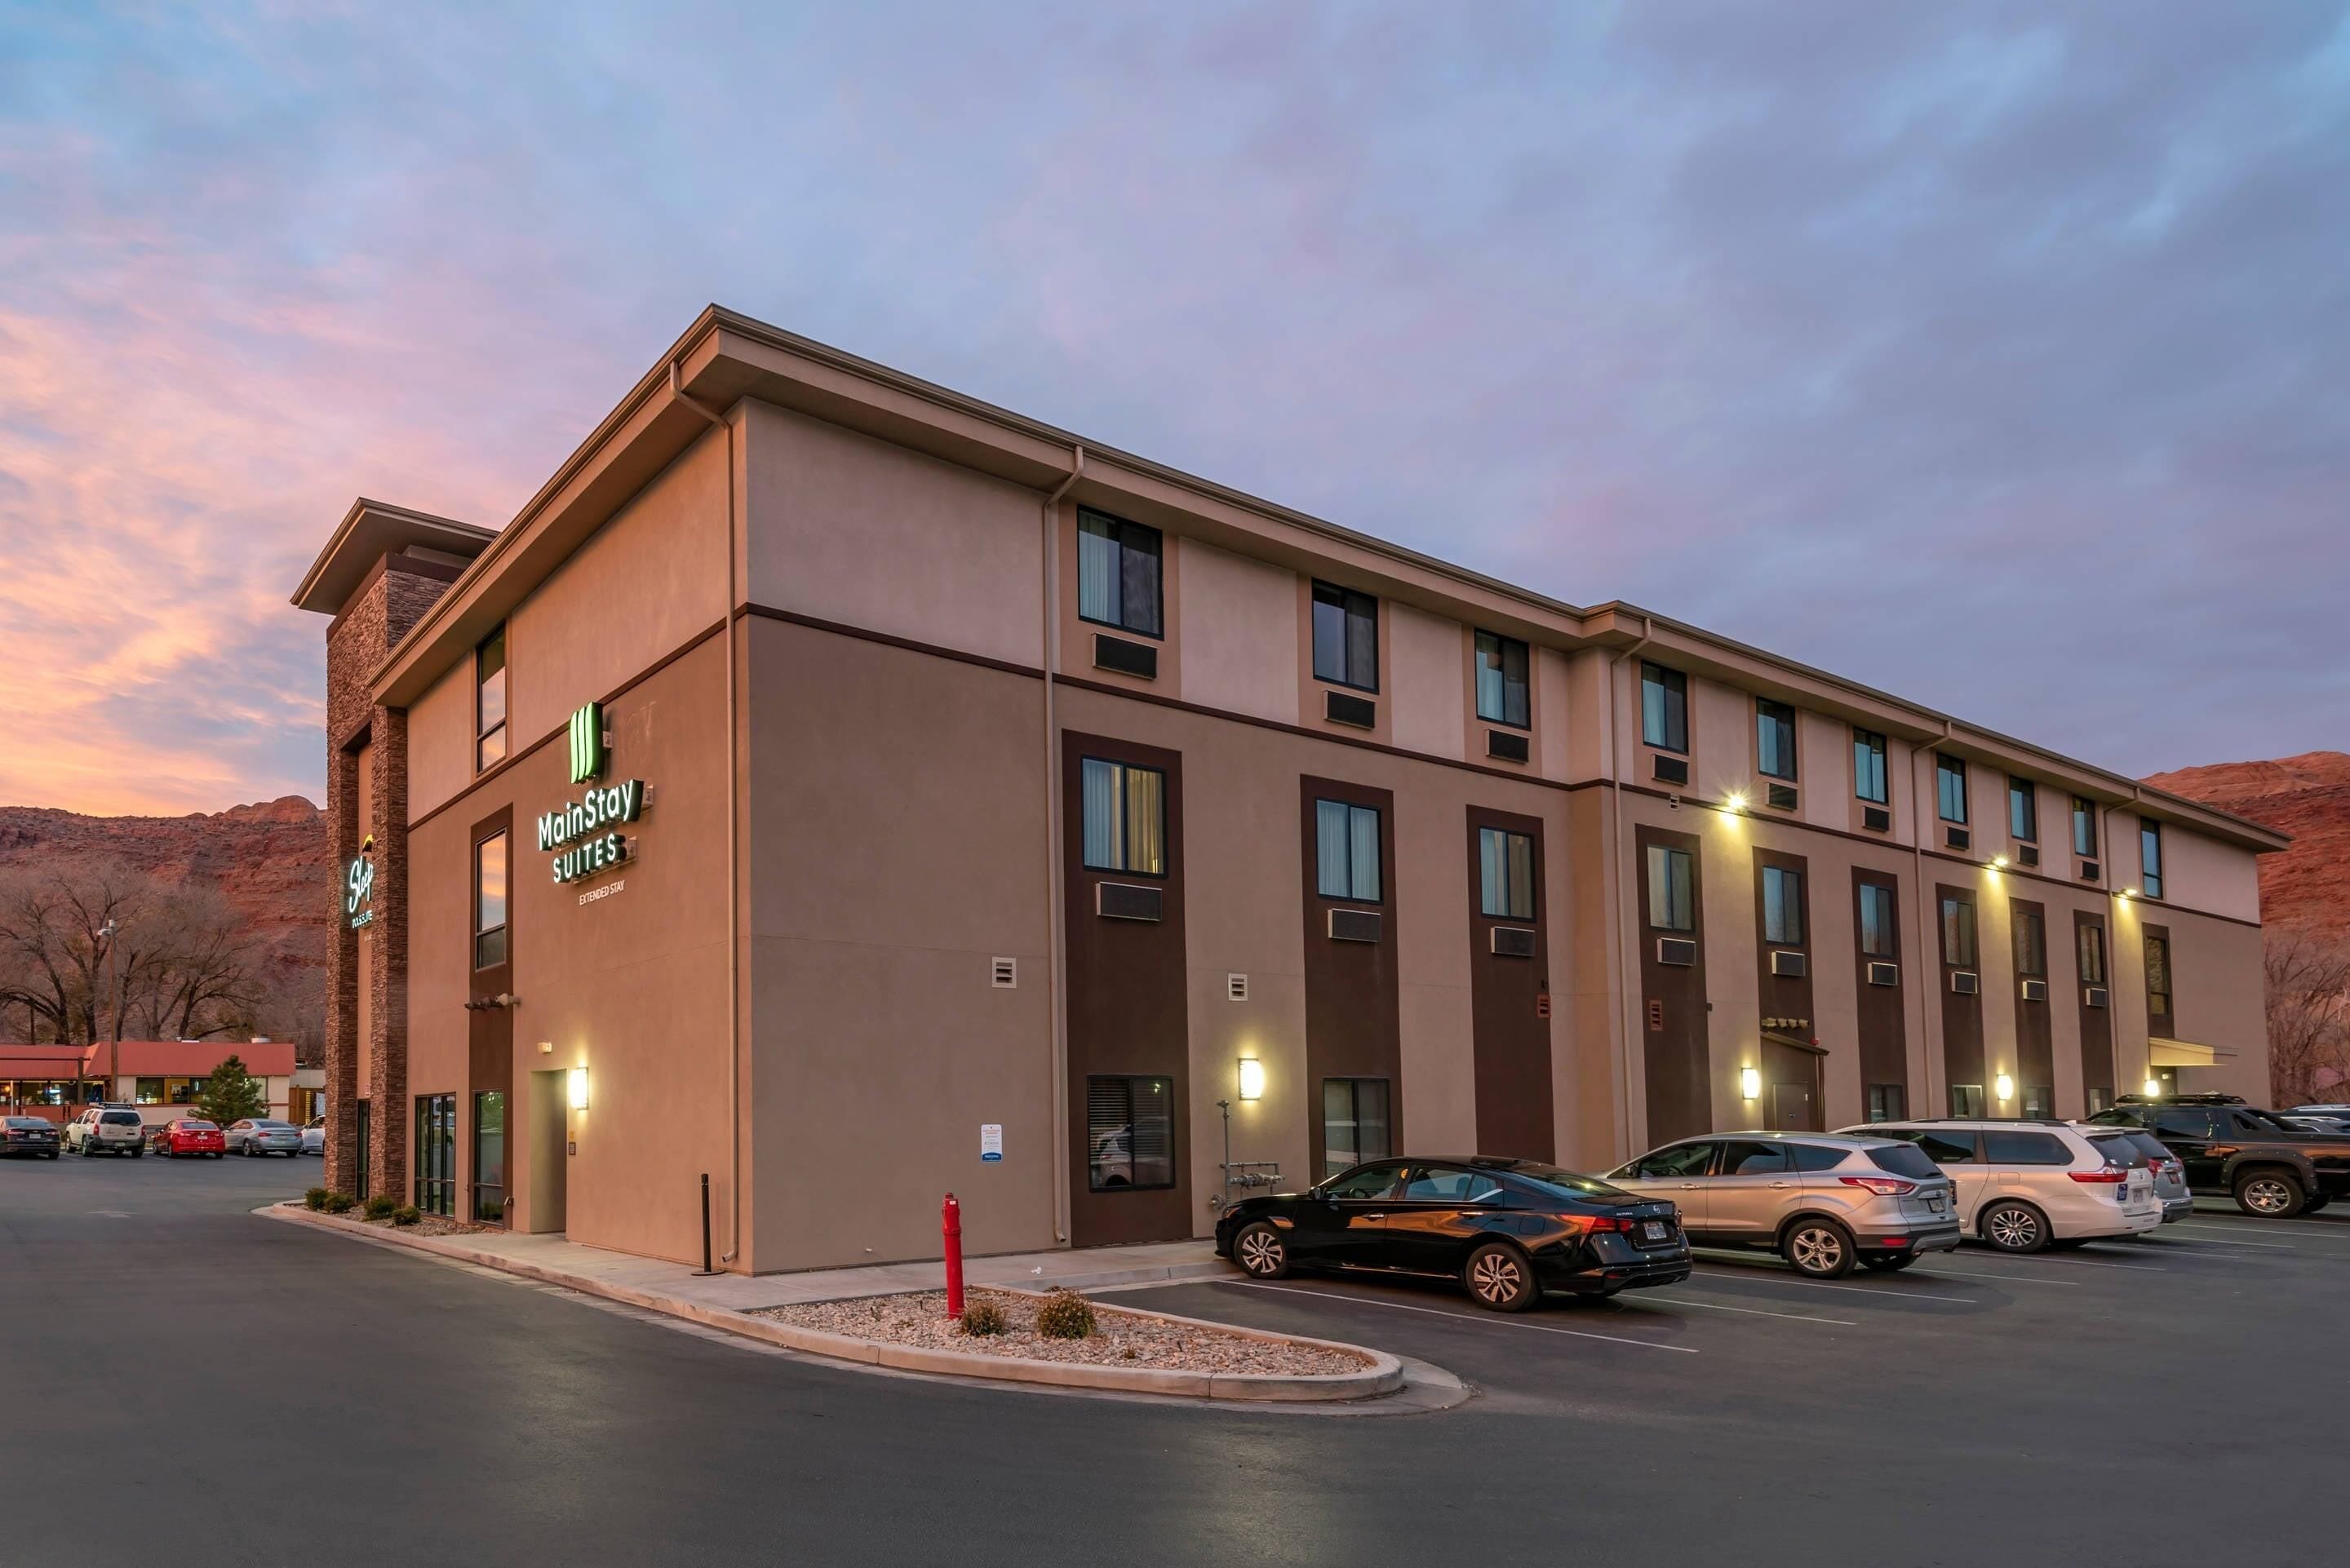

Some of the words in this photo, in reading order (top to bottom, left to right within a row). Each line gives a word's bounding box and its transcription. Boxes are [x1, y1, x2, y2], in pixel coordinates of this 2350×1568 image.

[539, 779, 634, 851] MainStay
[553, 833, 616, 884] SUITES
[579, 886, 609, 906] EXTENDED
[610, 880, 625, 894] STAY
